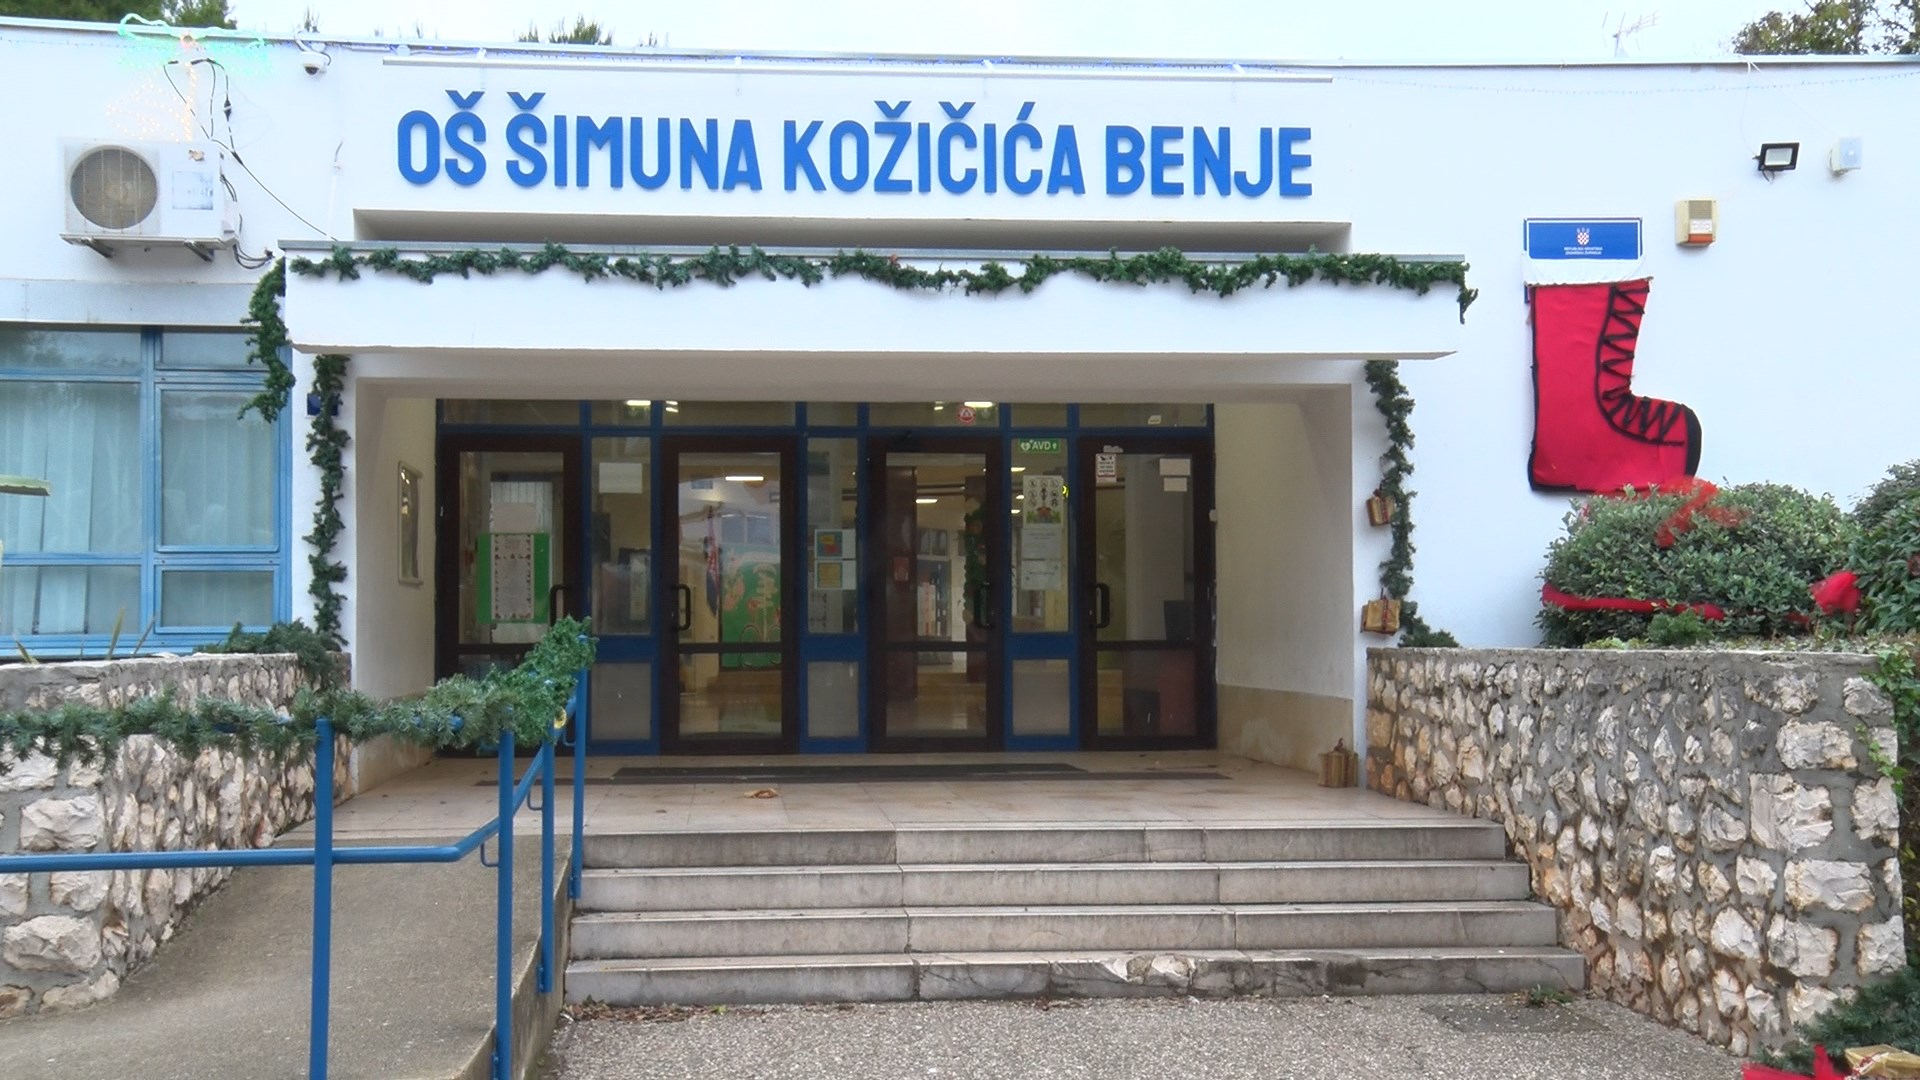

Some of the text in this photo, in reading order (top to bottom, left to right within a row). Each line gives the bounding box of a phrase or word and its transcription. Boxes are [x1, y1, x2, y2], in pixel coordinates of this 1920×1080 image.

[397, 91, 1312, 198] OŠ ŠIMUNA KOŽIČIĆA BENJE
[1032, 441, 1051, 450] AVD
